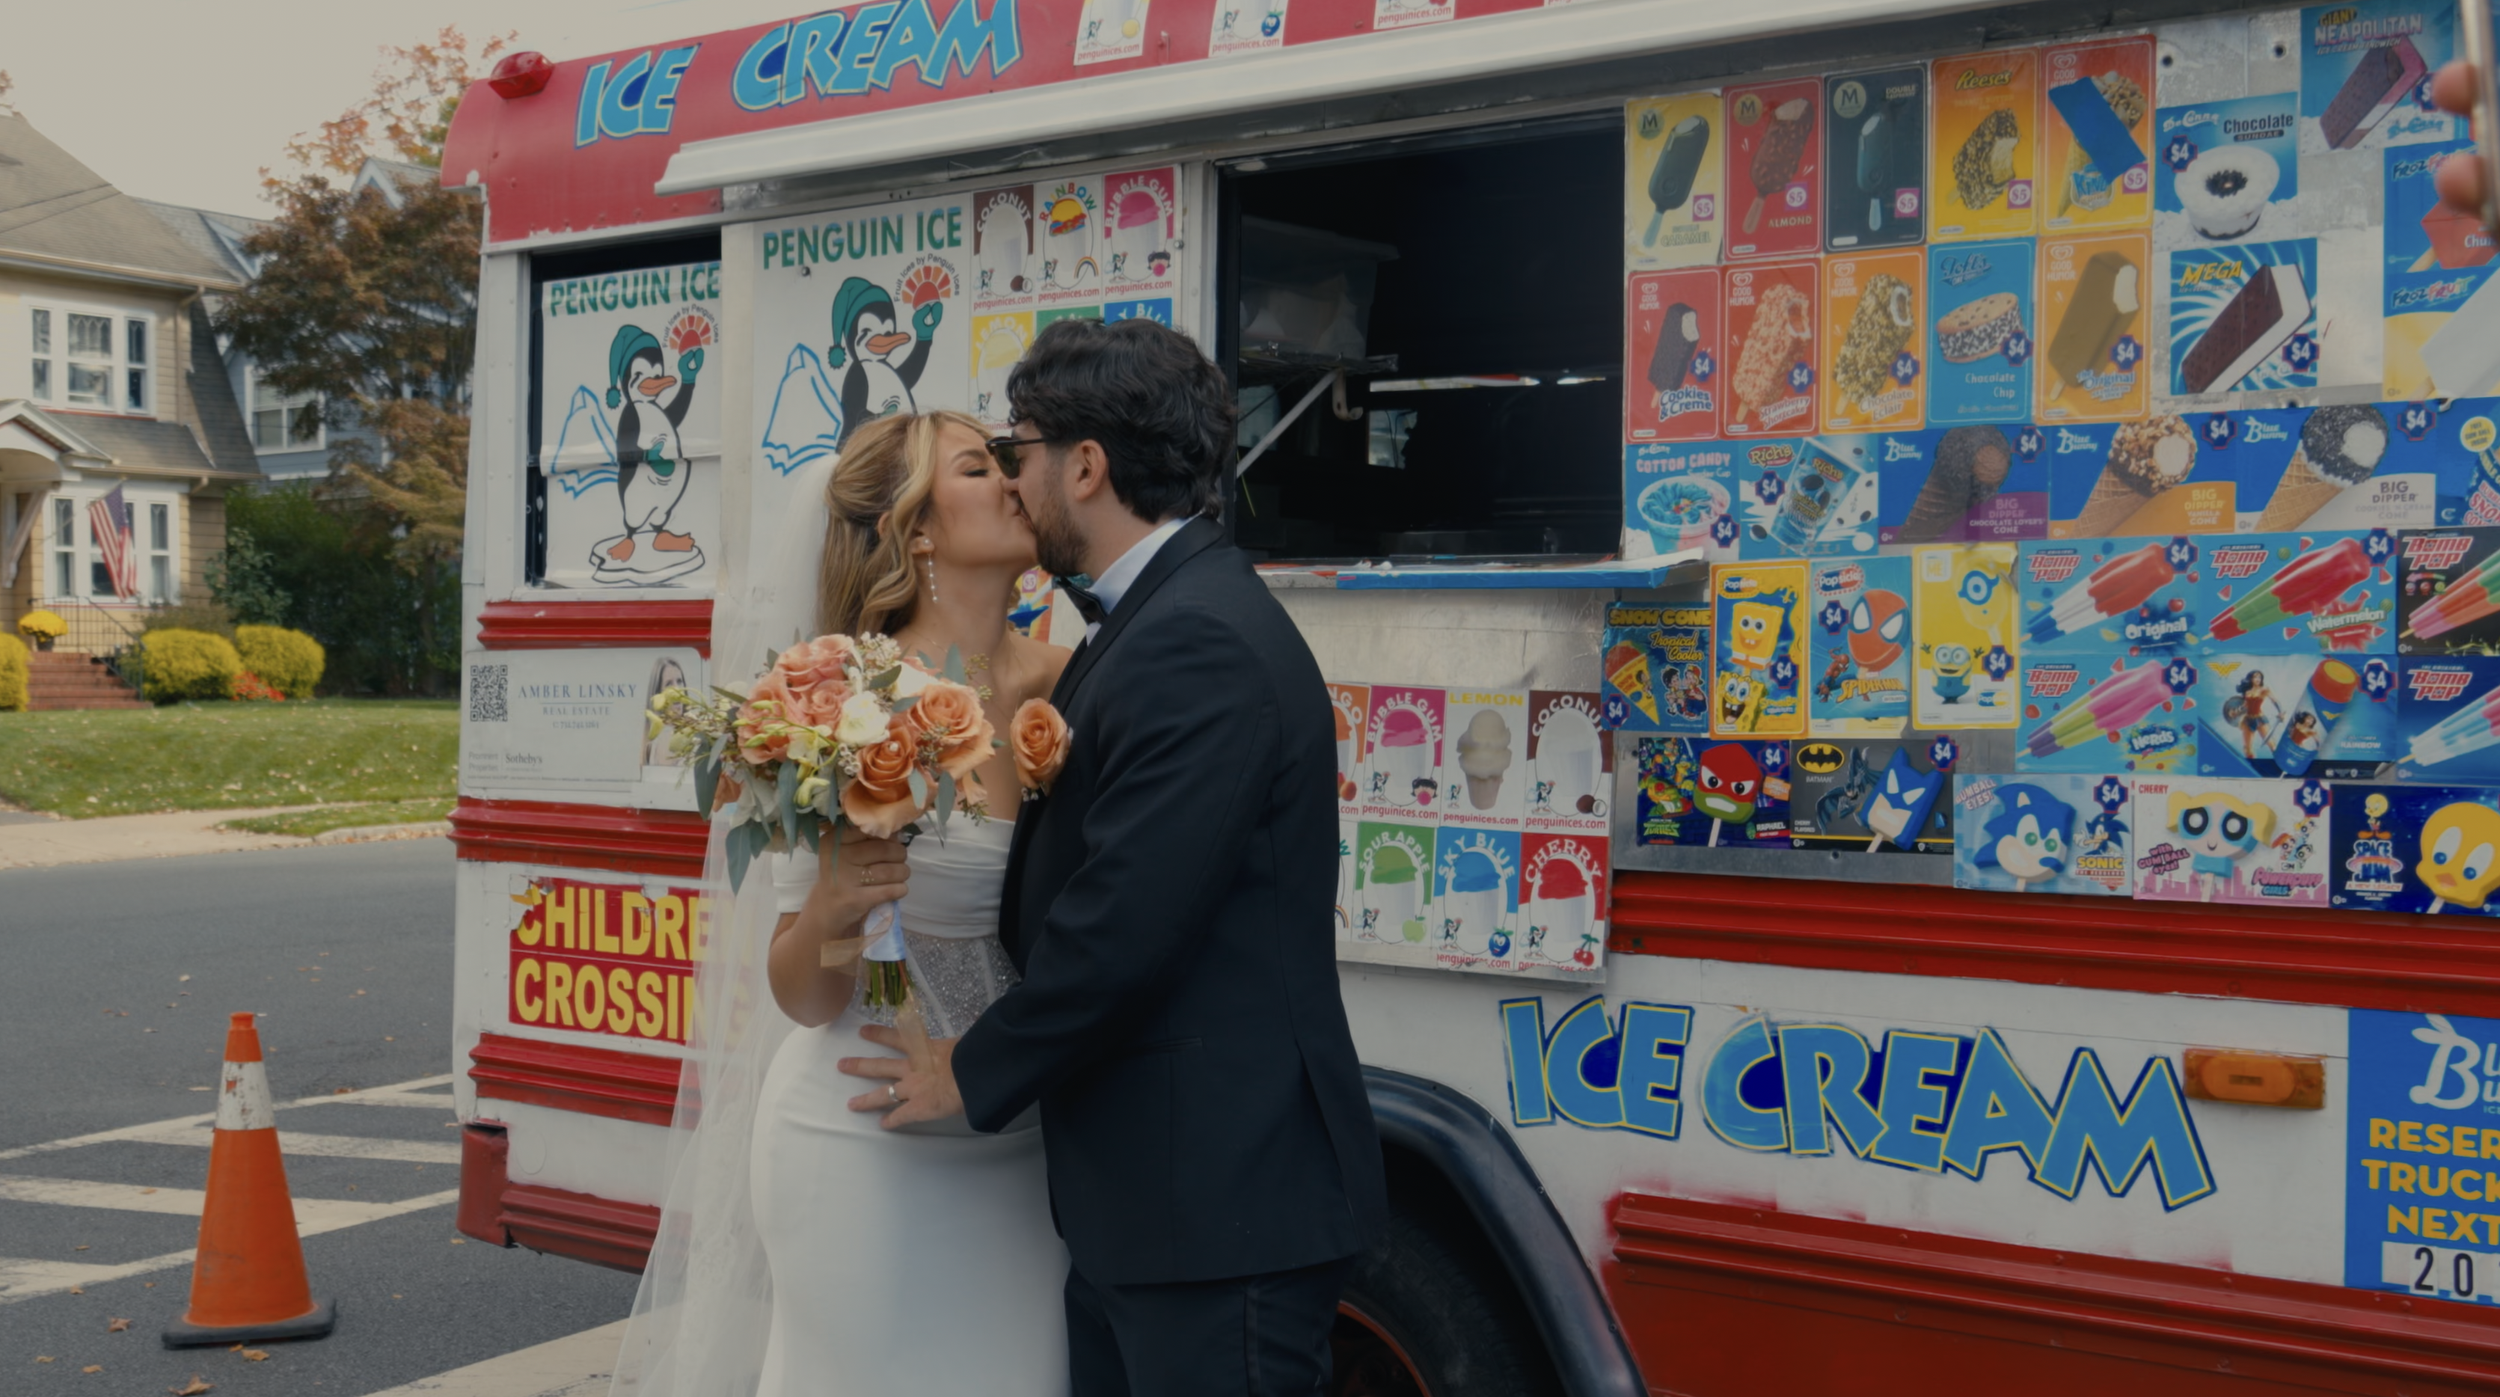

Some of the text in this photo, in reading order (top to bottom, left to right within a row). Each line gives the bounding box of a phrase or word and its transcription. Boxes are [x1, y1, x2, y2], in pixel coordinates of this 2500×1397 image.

[1377, 5, 1452, 26] penguinices.com
[2319, 9, 2356, 26] GIANT
[2315, 14, 2422, 46] NEAPOLITAN
[1076, 42, 1141, 63] penguinices.com
[1211, 37, 1280, 56] penguinices.com
[574, 0, 1025, 148] ICE CREAM
[2053, 69, 2076, 80] GOOD
[2223, 113, 2294, 134] Chocolate
[2237, 130, 2280, 141] SUNDAE
[2171, 143, 2189, 163] $4
[2126, 172, 2144, 187] $5
[1038, 181, 1098, 222] RAINBOW
[1105, 175, 1174, 229] BUBBLE GUM
[1787, 189, 1806, 204] $5
[2011, 187, 2028, 201] $5
[976, 192, 1033, 233] COCONUT
[1768, 215, 1813, 228] ALMOND
[763, 206, 963, 271] PENGUIN ICE
[927, 252, 956, 275] Penguin
[2050, 260, 2073, 271] GOOD
[2179, 260, 2243, 287] MEGA
[551, 261, 721, 317] PENGUIN ICE
[1037, 286, 1101, 304] penguinices.com
[1104, 279, 1173, 297] penguinices.com
[973, 294, 1034, 312] penguinices.com
[2008, 339, 2026, 357] $4
[2117, 344, 2135, 362] $4
[2291, 342, 2310, 362] $4
[1695, 358, 1710, 375] $4
[1896, 359, 1913, 377] $4
[1792, 369, 1809, 386] $4
[1965, 372, 2016, 385] Chocolate
[2083, 371, 2136, 391] Original
[1660, 384, 1710, 408] Cookies
[1859, 388, 1914, 414] Chocolate
[1993, 385, 2016, 400] Chip
[1669, 397, 1713, 414] Creme
[1759, 396, 1811, 420] Strawberry
[1872, 402, 1903, 422] Eclair
[1763, 406, 1807, 430] Shortcake
[2406, 410, 2427, 430] $4
[2210, 420, 2229, 441] $4
[2020, 434, 2038, 454] $4
[1636, 452, 1731, 474] COTTON CANDY
[1749, 445, 1794, 466] Rich's
[1812, 458, 1844, 481] Rich's
[1762, 479, 1778, 496] $4
[2192, 488, 2217, 501] BIG
[2380, 480, 2409, 494] BIG
[1995, 498, 2019, 509] BIG
[2184, 500, 2224, 511] DIPPER
[2372, 493, 2416, 504] DIPPER
[1988, 509, 2025, 519] DIPPER
[2189, 517, 2218, 526] CONE
[2378, 511, 2409, 520] CONE
[1717, 522, 1733, 539] $4
[1969, 519, 2012, 527] CHOCOLATE
[1993, 526, 2019, 534] CONE
[2369, 537, 2388, 555] $4
[2404, 536, 2473, 552] BOMB
[2029, 554, 2080, 568] BOMB
[2171, 545, 2189, 563] $4
[2212, 551, 2268, 565] BOMB
[2410, 552, 2462, 569] POP
[1819, 571, 1863, 588] Popsicle
[2033, 568, 2073, 582] POP
[2216, 564, 2260, 578] POP
[1609, 608, 1711, 627] SNOW CONE
[1826, 608, 1842, 626] $4
[2307, 608, 2386, 633] Watermelon
[2125, 617, 2188, 640] Original
[1650, 631, 1698, 652] Tropical
[1668, 645, 1704, 662] Cooler
[1989, 653, 2007, 671] $4
[1776, 663, 1793, 680] $4
[2028, 669, 2079, 683] BOMB
[2170, 667, 2189, 685] $4
[2408, 669, 2473, 685] BOMB
[2032, 682, 2072, 697] POP
[2366, 673, 2387, 692] $4
[517, 684, 638, 699] AMBER LINSKY
[1450, 692, 1523, 707] LEMON
[2414, 684, 2463, 700] POP
[542, 706, 611, 716] REAL ESTATE
[1366, 692, 1444, 743] BUBBLE GUM
[1608, 702, 1624, 718] $4
[1934, 743, 1952, 760] $4
[2340, 741, 2381, 749] RAINBOW
[505, 752, 543, 767] Sotheby's
[1765, 747, 1782, 767] $4
[1806, 776, 1832, 784] BATMAN
[1955, 778, 1998, 805] GUMBALL
[2102, 785, 2120, 802] $4
[2138, 783, 2169, 795] CHERRY
[2302, 788, 2323, 806] $4
[1965, 790, 1995, 811] EYES!
[1362, 804, 1439, 820] penguinices.com
[1442, 813, 1520, 826] penguinices.com
[1525, 815, 1607, 830] penguinices.com
[1755, 821, 1787, 832] RAPHAEL
[1358, 830, 1391, 873] SOUR
[1395, 830, 1432, 875] APPLE
[1438, 832, 1516, 880] SKY BLUE
[2149, 843, 2173, 856] with
[2355, 841, 2391, 857] SPACE
[1524, 838, 1604, 885] CHERRY
[2076, 857, 2125, 870] SONIC
[2138, 848, 2190, 869] GUM BALL
[2262, 886, 2290, 896] GIRLS
[516, 885, 721, 961] CHILDRE
[1500, 994, 2217, 1213] ICE CREAM
[2361, 1159, 2500, 1202] TRUCK
[2387, 1204, 2500, 1246] NEXT
